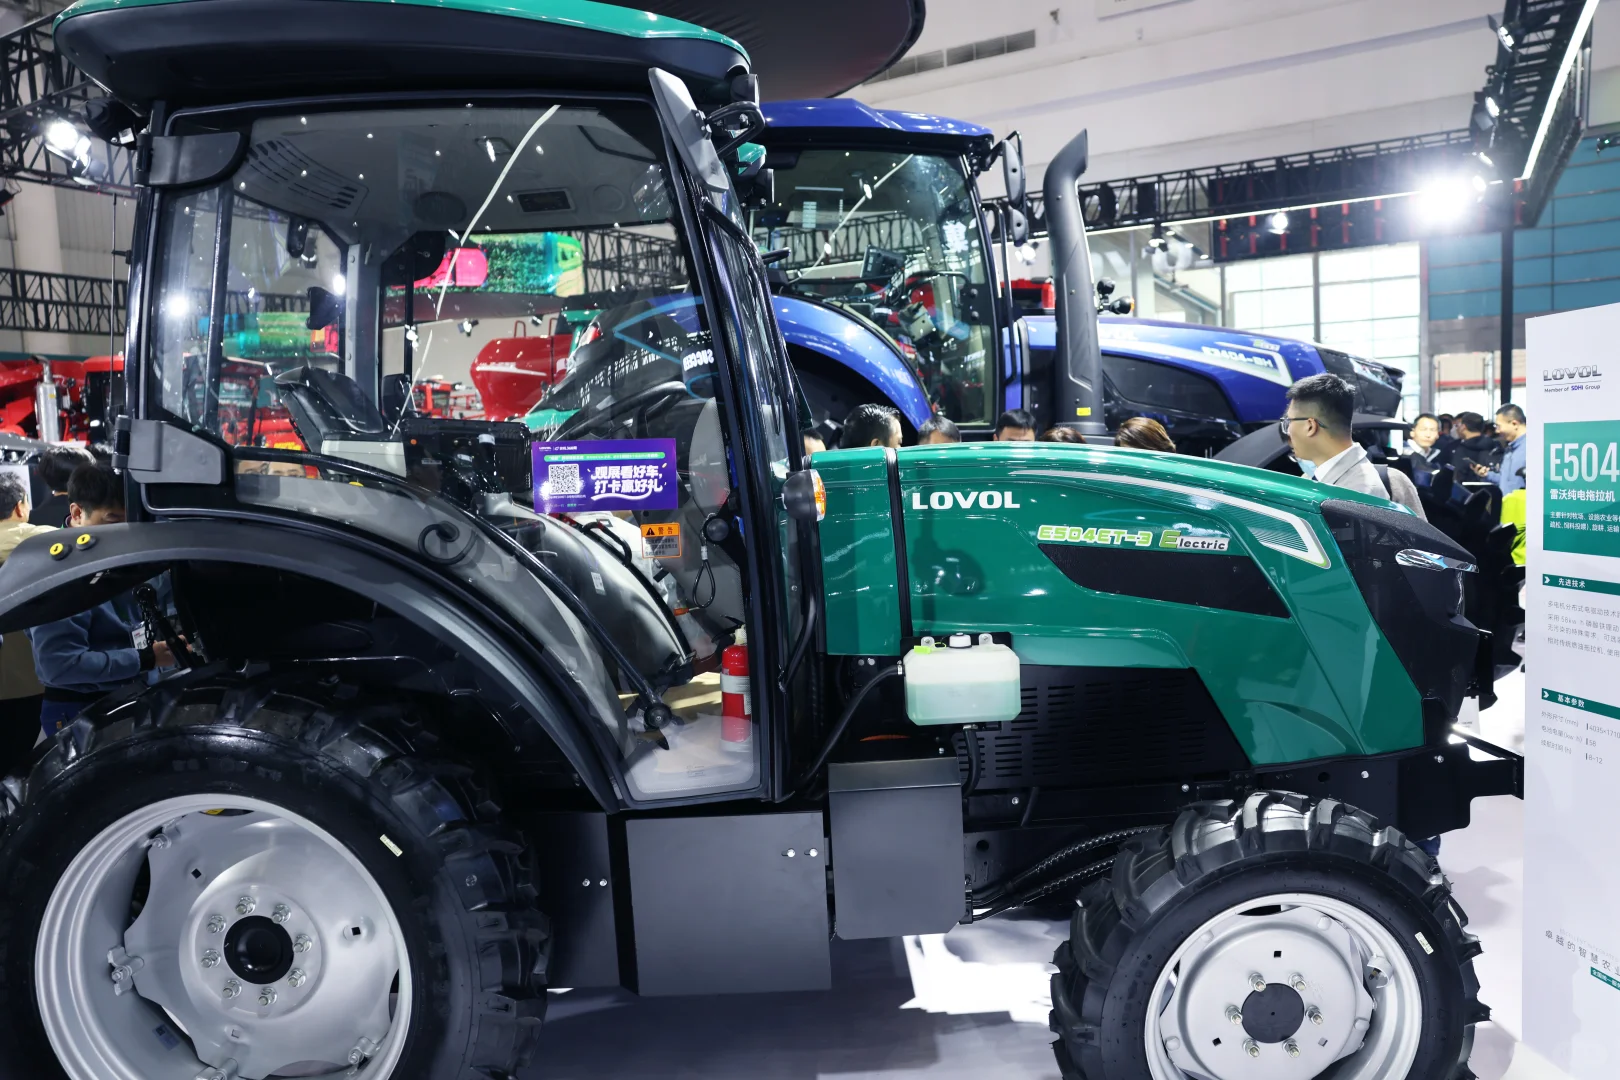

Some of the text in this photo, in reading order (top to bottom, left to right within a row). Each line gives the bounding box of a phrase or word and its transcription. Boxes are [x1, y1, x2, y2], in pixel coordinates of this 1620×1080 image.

[1542, 364, 1602, 381] LOVOL
[1549, 441, 1620, 483] E504
[594, 478, 664, 494] 打卡赢好礼
[912, 491, 1021, 510] LOVOL
[1550, 488, 1616, 502] 雷沃纯电拖拉机
[1550, 511, 1620, 523] 主要针对牧场、设施农业等
[657, 526, 674, 535] 警告
[1038, 525, 1226, 550] E504ET-3 Electric
[1558, 578, 1586, 588] 先进技术
[1557, 694, 1585, 708] 基本参数
